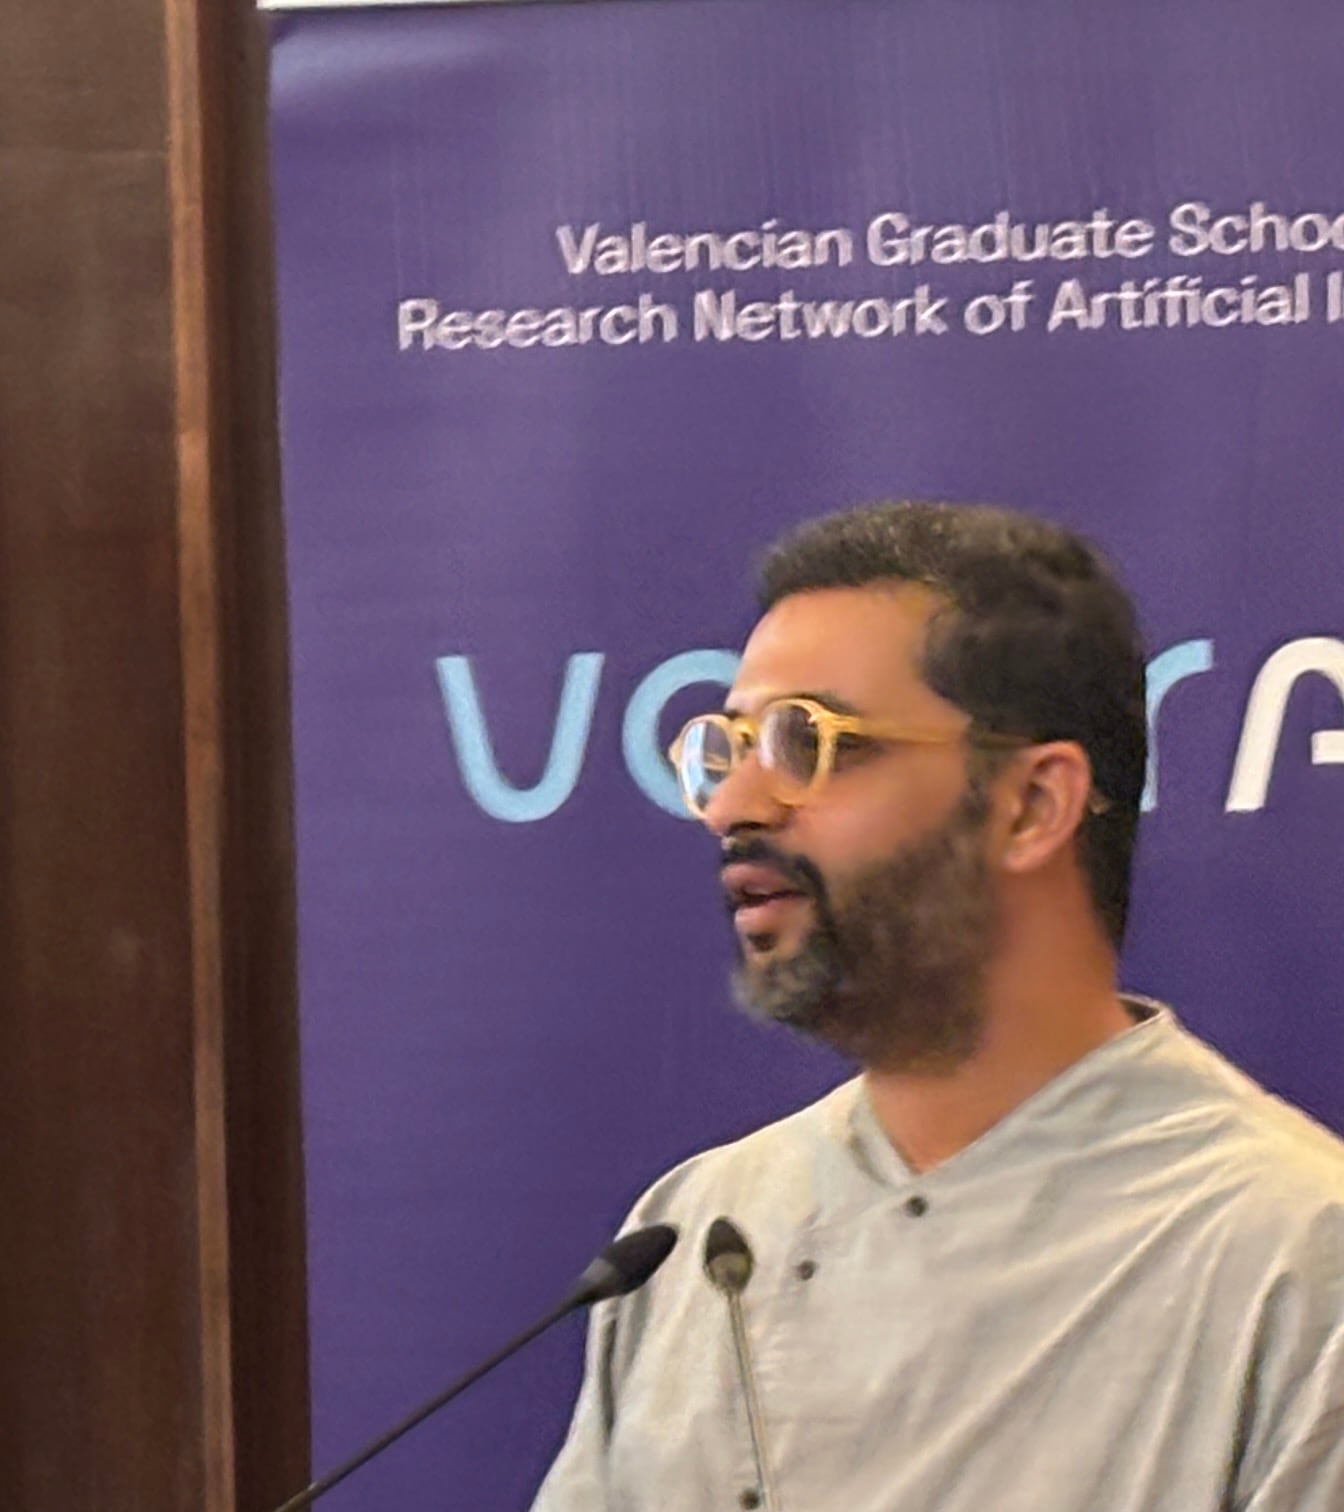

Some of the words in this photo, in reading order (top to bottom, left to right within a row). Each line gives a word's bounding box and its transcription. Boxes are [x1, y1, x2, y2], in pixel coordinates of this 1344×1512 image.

[556, 219, 852, 274] Valencian
[866, 211, 1154, 266] Graduate
[398, 294, 677, 350] Research
[694, 286, 948, 342] Network
[964, 280, 1036, 335] of
[1048, 273, 1309, 332] Artificial
